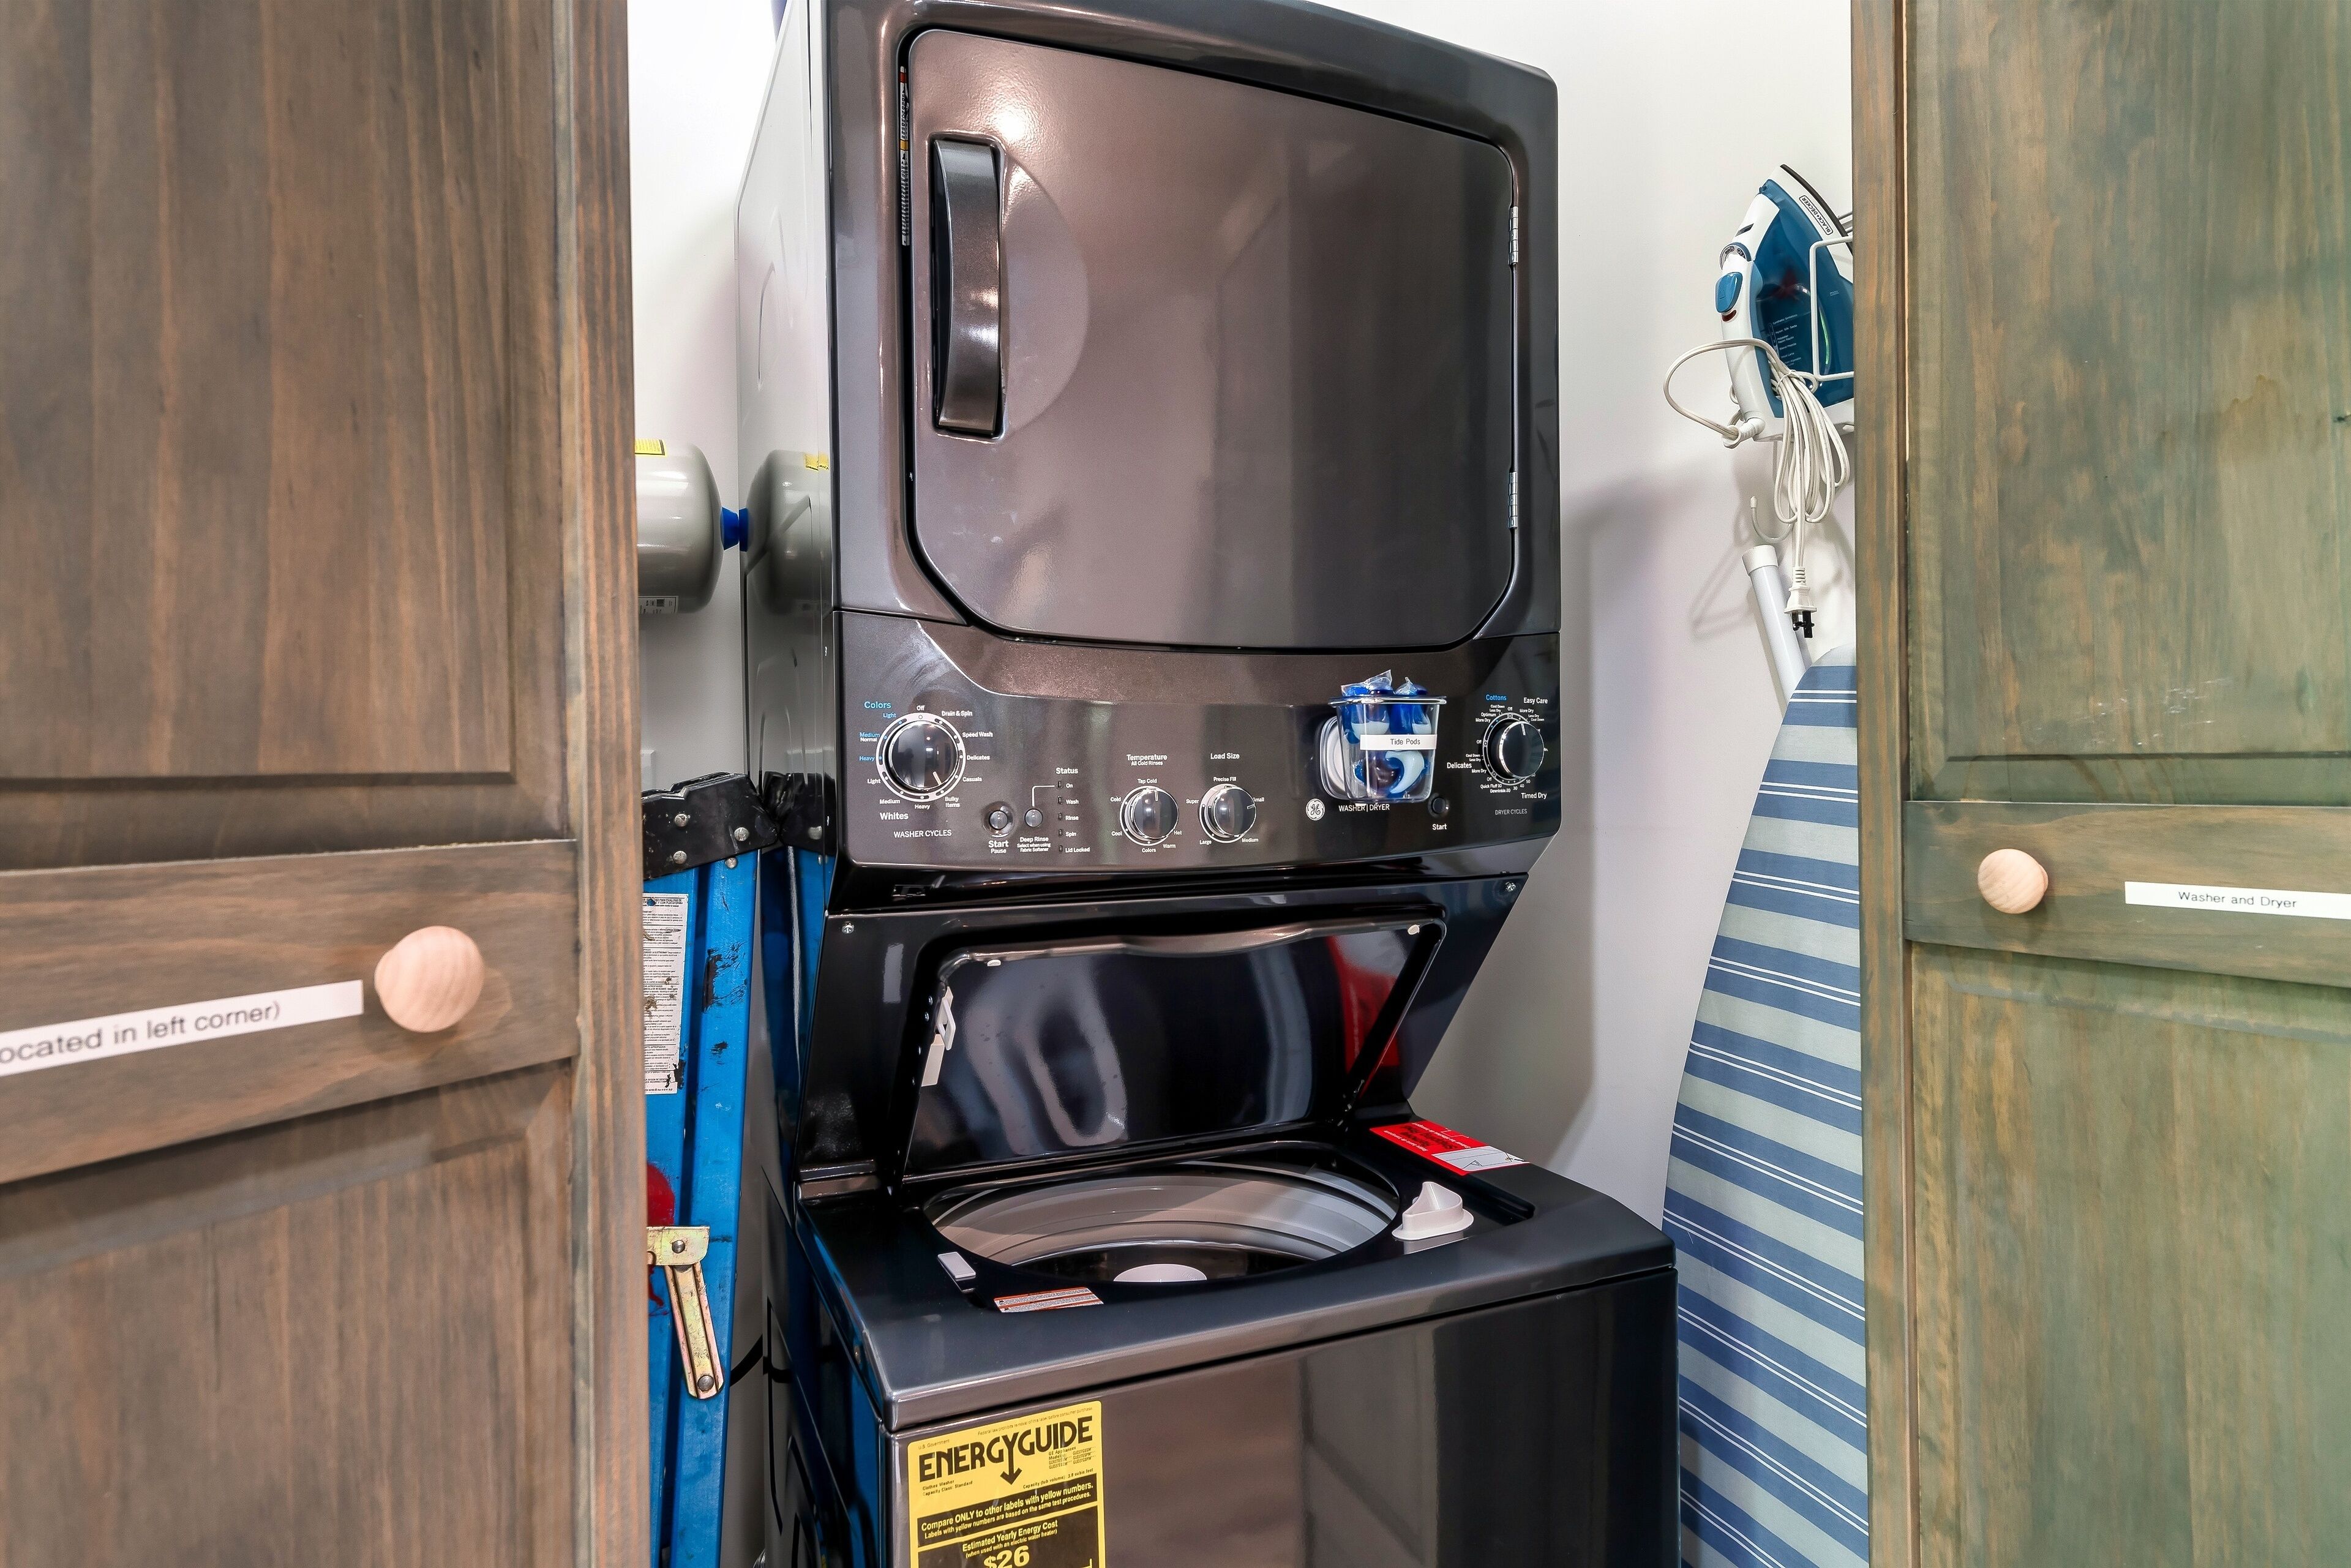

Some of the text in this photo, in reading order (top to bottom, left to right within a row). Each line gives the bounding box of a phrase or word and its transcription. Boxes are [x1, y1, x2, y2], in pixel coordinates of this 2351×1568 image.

[1802, 197, 1831, 233] BLACK+DECKER
[880, 812, 909, 820] Whites
[2178, 891, 2298, 909] Washer and Dryer
[113, 1024, 137, 1045] in
[146, 1016, 186, 1041] left
[194, 1000, 280, 1033] corner)
[919, 1415, 1093, 1483] ENERGYGUIDE
[921, 1482, 1093, 1531] Compare ONLY to other labels with yellow numbers.
[924, 1528, 942, 1539] Labels
[955, 1521, 972, 1533] yellow
[973, 1515, 996, 1526] numbers
[1005, 1507, 1021, 1518] based
[1062, 1491, 1091, 1506] procedures.
[962, 1520, 1058, 1552] Estimated Yearly Energy Cost
[966, 1549, 980, 1559] (when
[980, 1545, 992, 1554] used
[1010, 1536, 1027, 1546] electric
[1041, 1528, 1057, 1537] heater)
[983, 1545, 1030, 1568] $26
